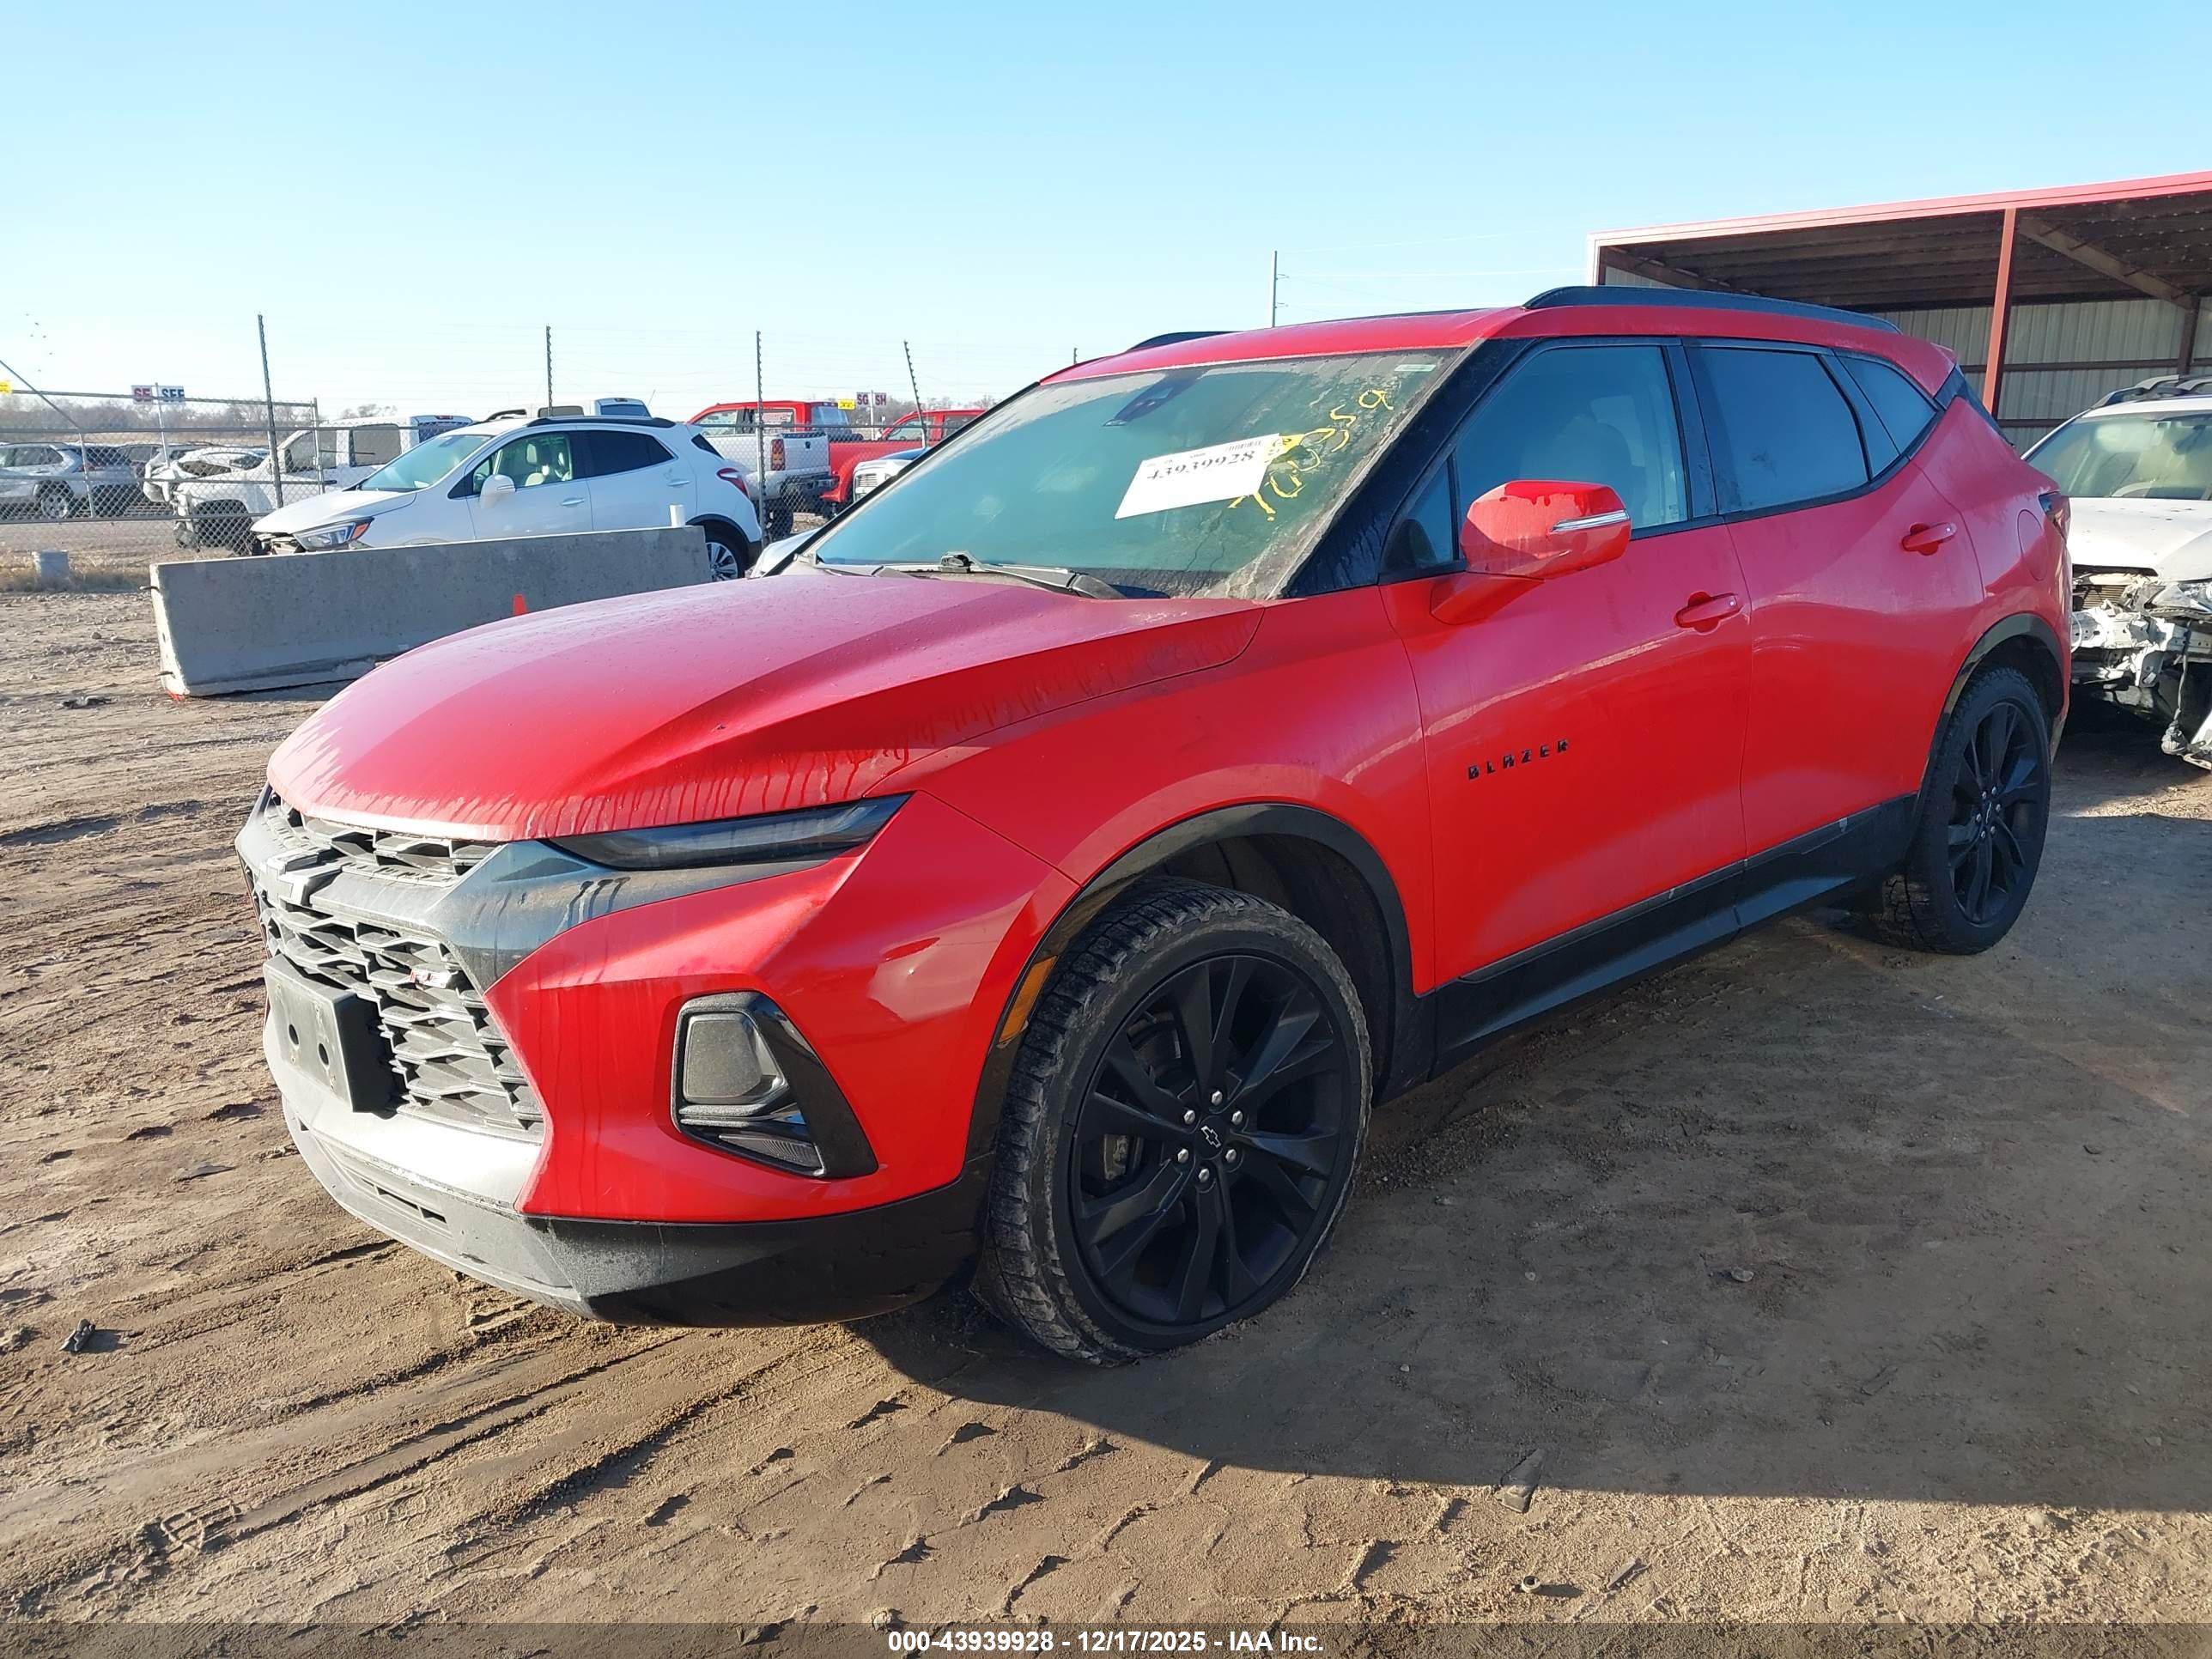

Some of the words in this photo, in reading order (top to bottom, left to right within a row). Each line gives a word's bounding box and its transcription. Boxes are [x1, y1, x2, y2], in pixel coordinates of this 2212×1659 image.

[857, 394, 869, 405] SG
[875, 395, 886, 405] SH
[1146, 450, 1255, 480] 43939928
[1468, 738, 1568, 780] BLAZER
